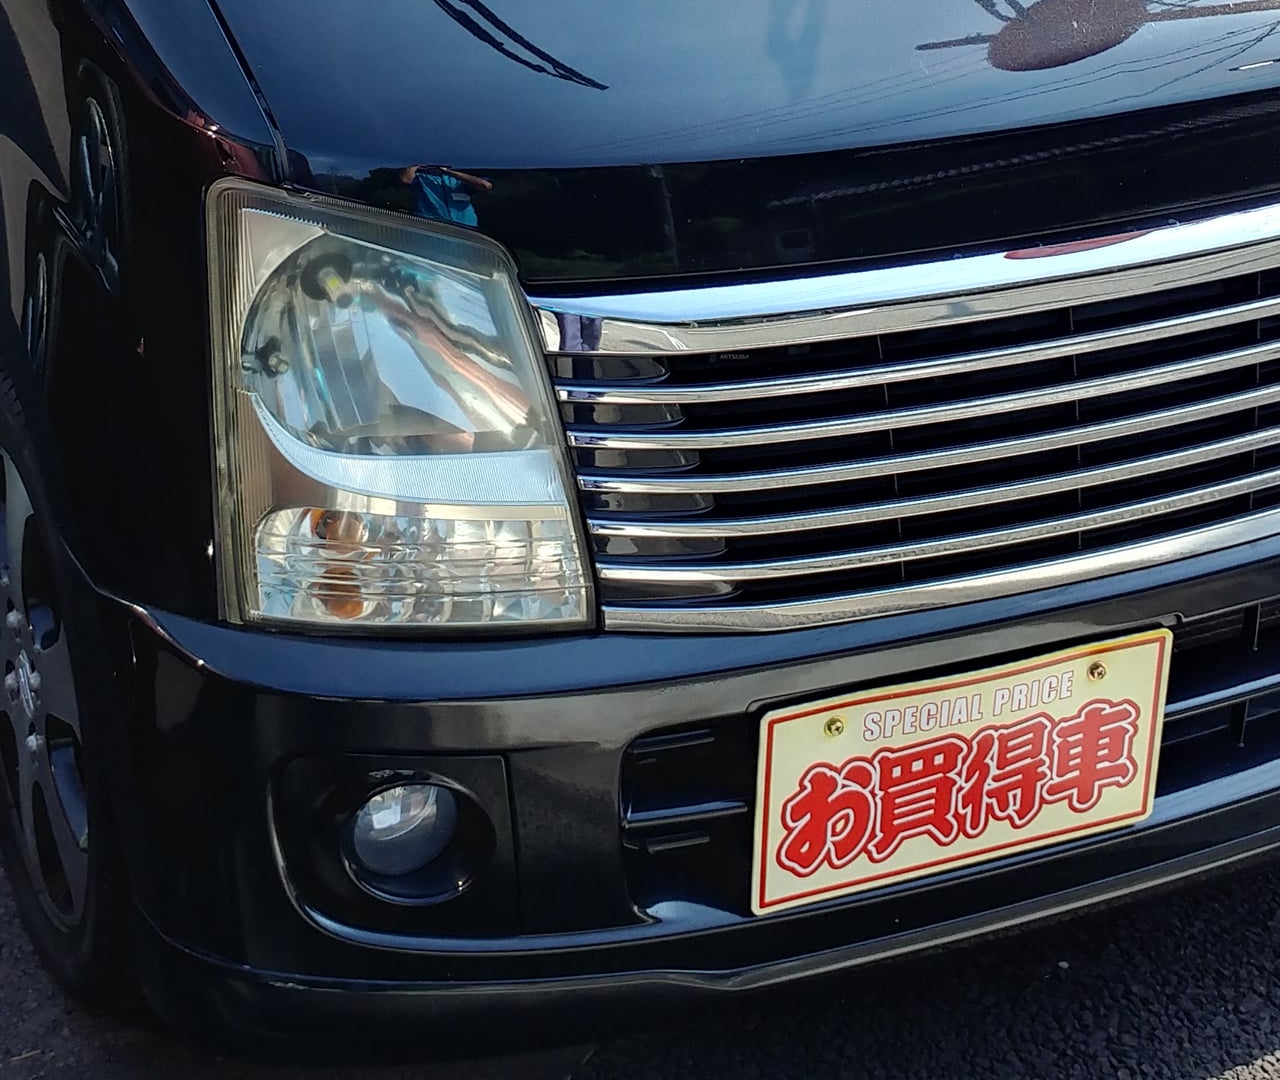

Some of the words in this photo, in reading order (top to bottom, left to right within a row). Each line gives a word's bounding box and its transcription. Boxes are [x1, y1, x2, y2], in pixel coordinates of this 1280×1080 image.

[863, 692, 984, 742] SPECIAL
[993, 670, 1075, 717] PRICE
[776, 698, 1142, 877] お買得車
